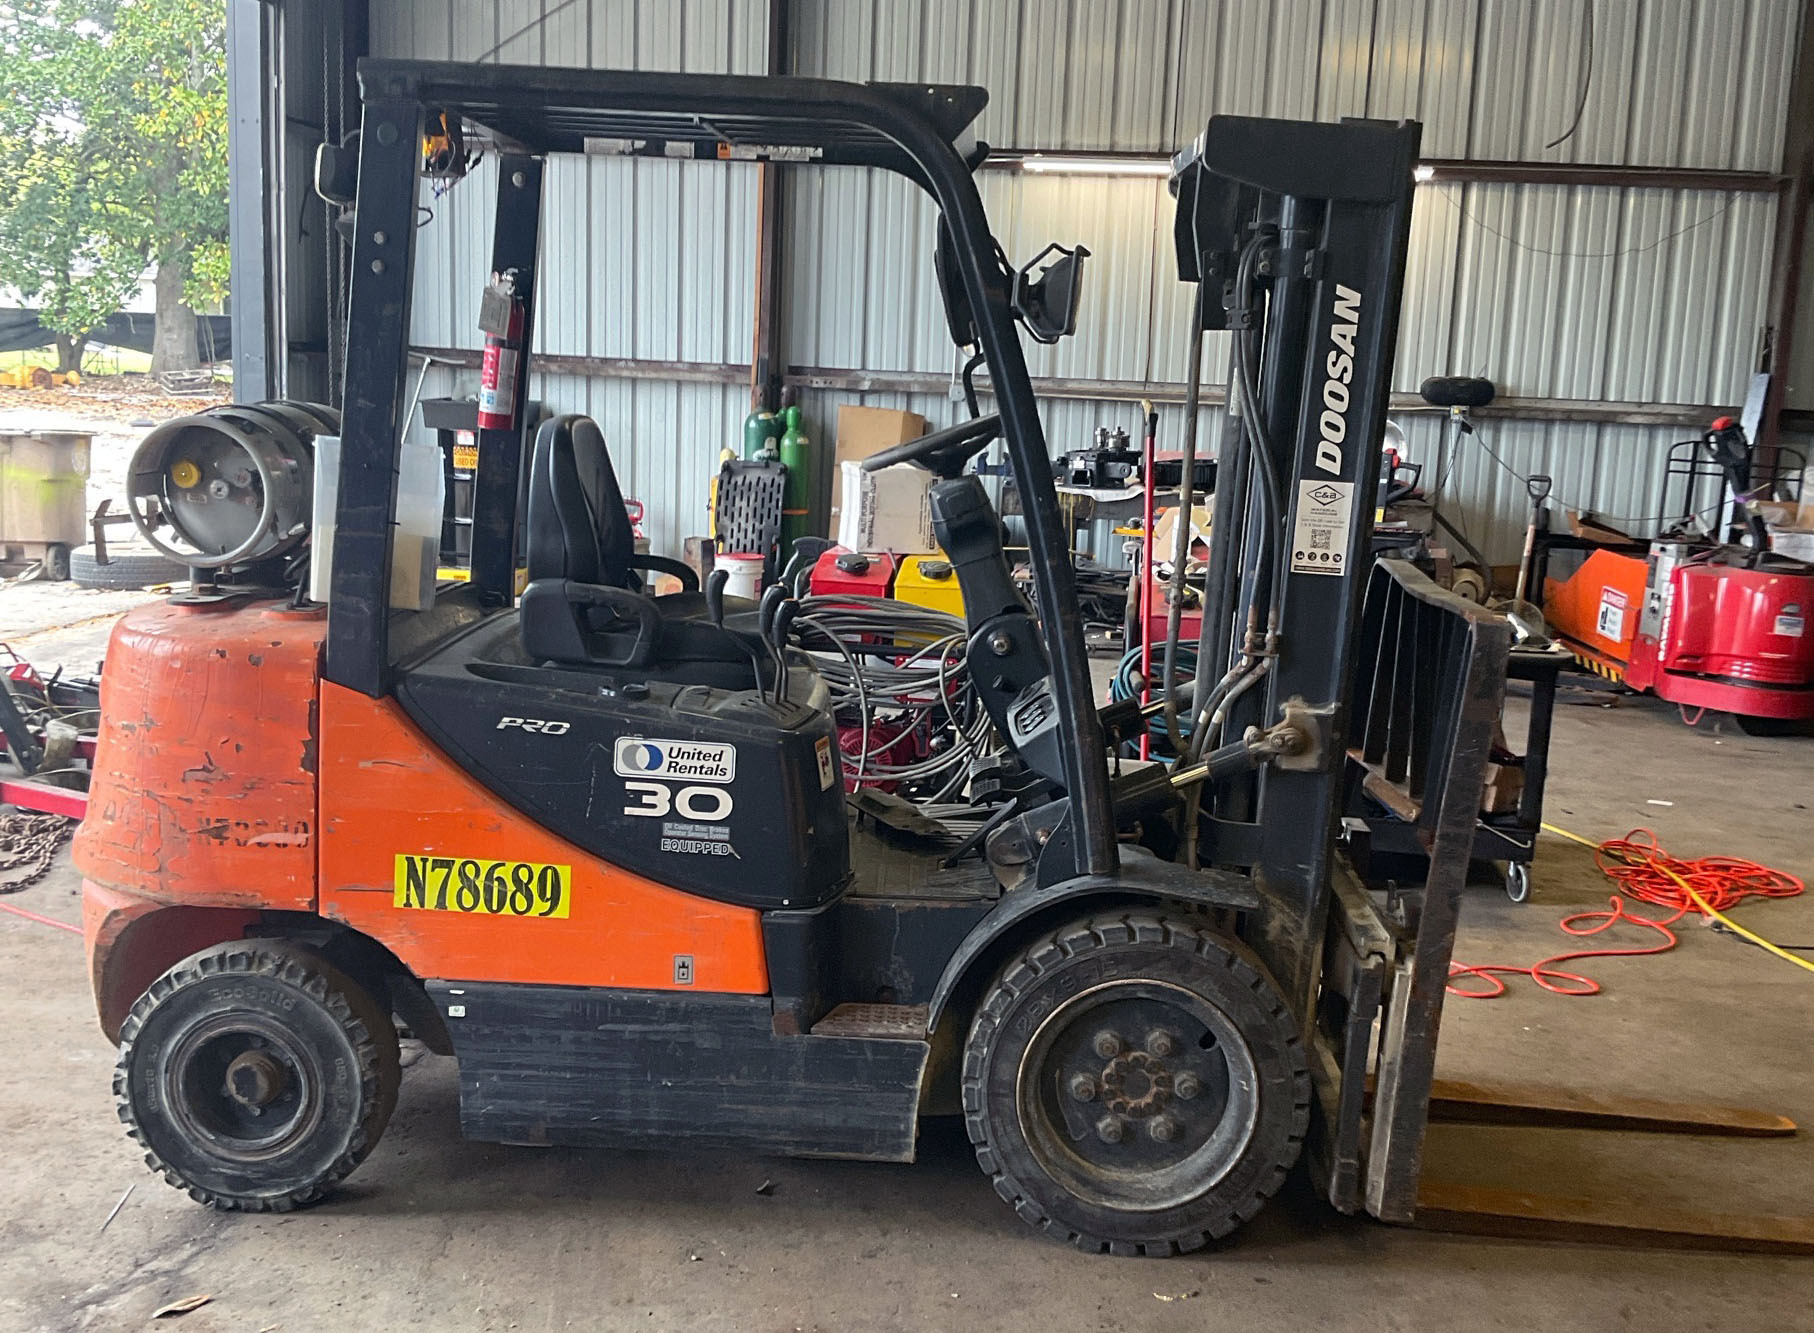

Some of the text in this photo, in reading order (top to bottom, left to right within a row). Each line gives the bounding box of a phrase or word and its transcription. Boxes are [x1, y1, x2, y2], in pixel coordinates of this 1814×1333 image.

[1315, 284, 1361, 475] DOOSAN
[497, 717, 571, 735] PRO
[668, 747, 724, 762] United
[666, 761, 728, 776] Rentals
[624, 781, 733, 821] 30
[661, 838, 730, 855] EQUIPPED
[403, 856, 562, 917] N78689
